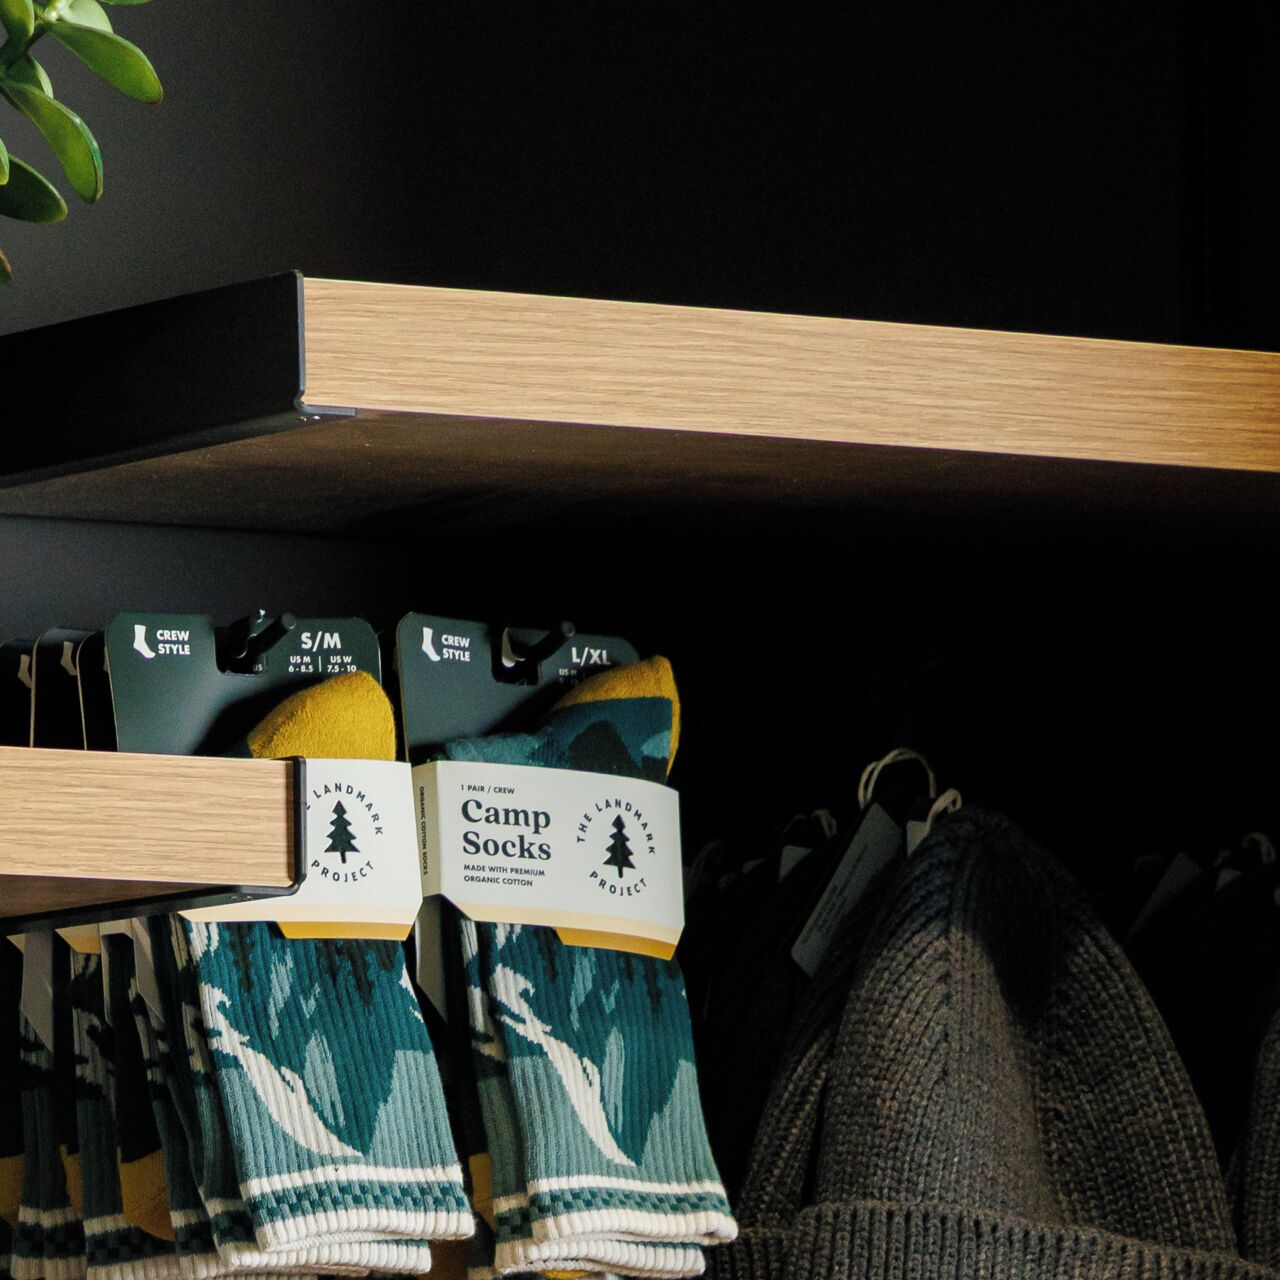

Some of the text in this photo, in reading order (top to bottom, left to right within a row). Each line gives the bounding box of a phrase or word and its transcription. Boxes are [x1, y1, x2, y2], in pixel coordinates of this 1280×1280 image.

[156, 630, 190, 641] CREW
[301, 630, 342, 652] S/M
[441, 634, 470, 648] CREW
[158, 643, 191, 655] STYLE
[442, 647, 471, 662] STYLE
[290, 655, 311, 664] US M
[330, 655, 352, 664] US W
[571, 646, 612, 667] L/XL
[288, 664, 295, 673] 6
[300, 664, 314, 673] 8.5
[327, 664, 340, 673] 7.5
[347, 664, 357, 673] 10
[467, 784, 485, 793] PAIR
[493, 786, 515, 795] CREW
[312, 782, 384, 836] LANDMARK
[461, 798, 552, 836] Camp
[576, 798, 657, 855] THE LANDMARK
[462, 830, 553, 861] Socks
[310, 859, 375, 883] PROJECT
[463, 863, 546, 877] MADE WITH PREMIUM
[463, 875, 534, 887] ORGANIC COTTON
[589, 870, 648, 897] PROJECT
